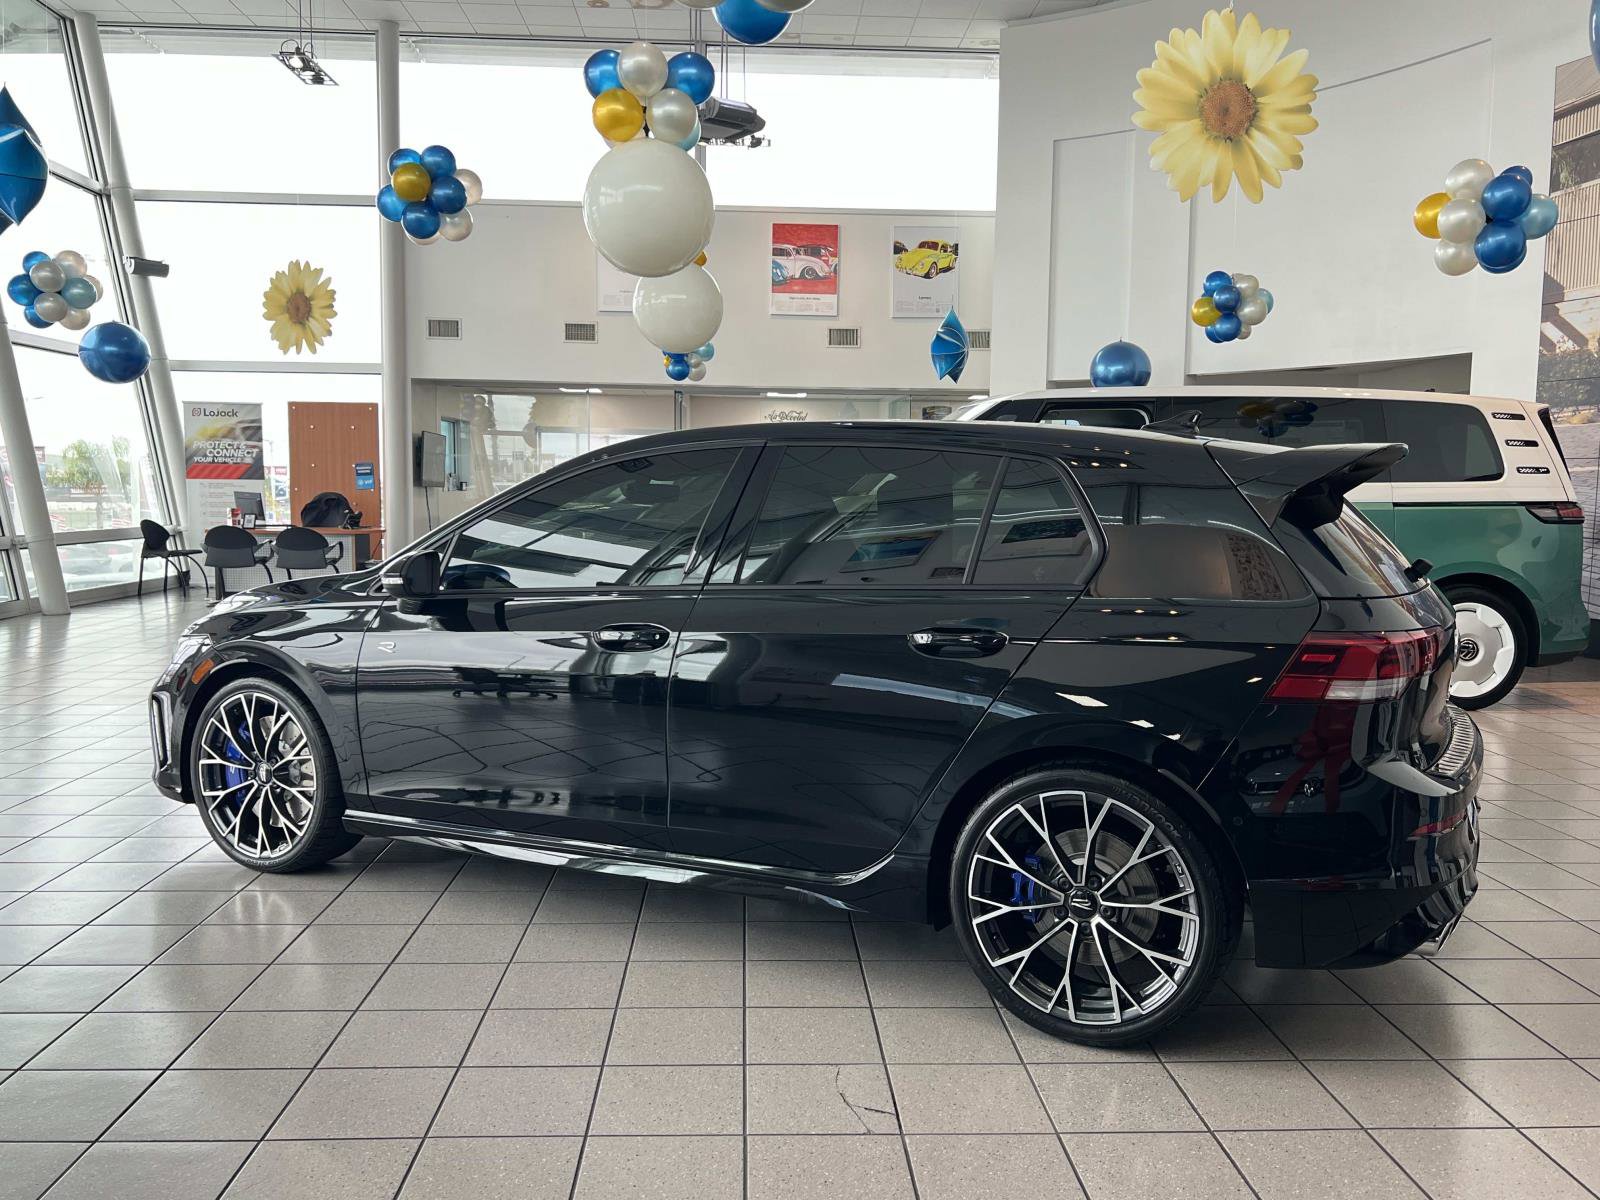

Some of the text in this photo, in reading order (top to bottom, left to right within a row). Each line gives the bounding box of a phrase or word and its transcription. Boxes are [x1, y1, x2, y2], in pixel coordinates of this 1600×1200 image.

[193, 440, 239, 450] PROTECT
[206, 448, 258, 458] CONNECT
[214, 456, 243, 464] VEHICLE
